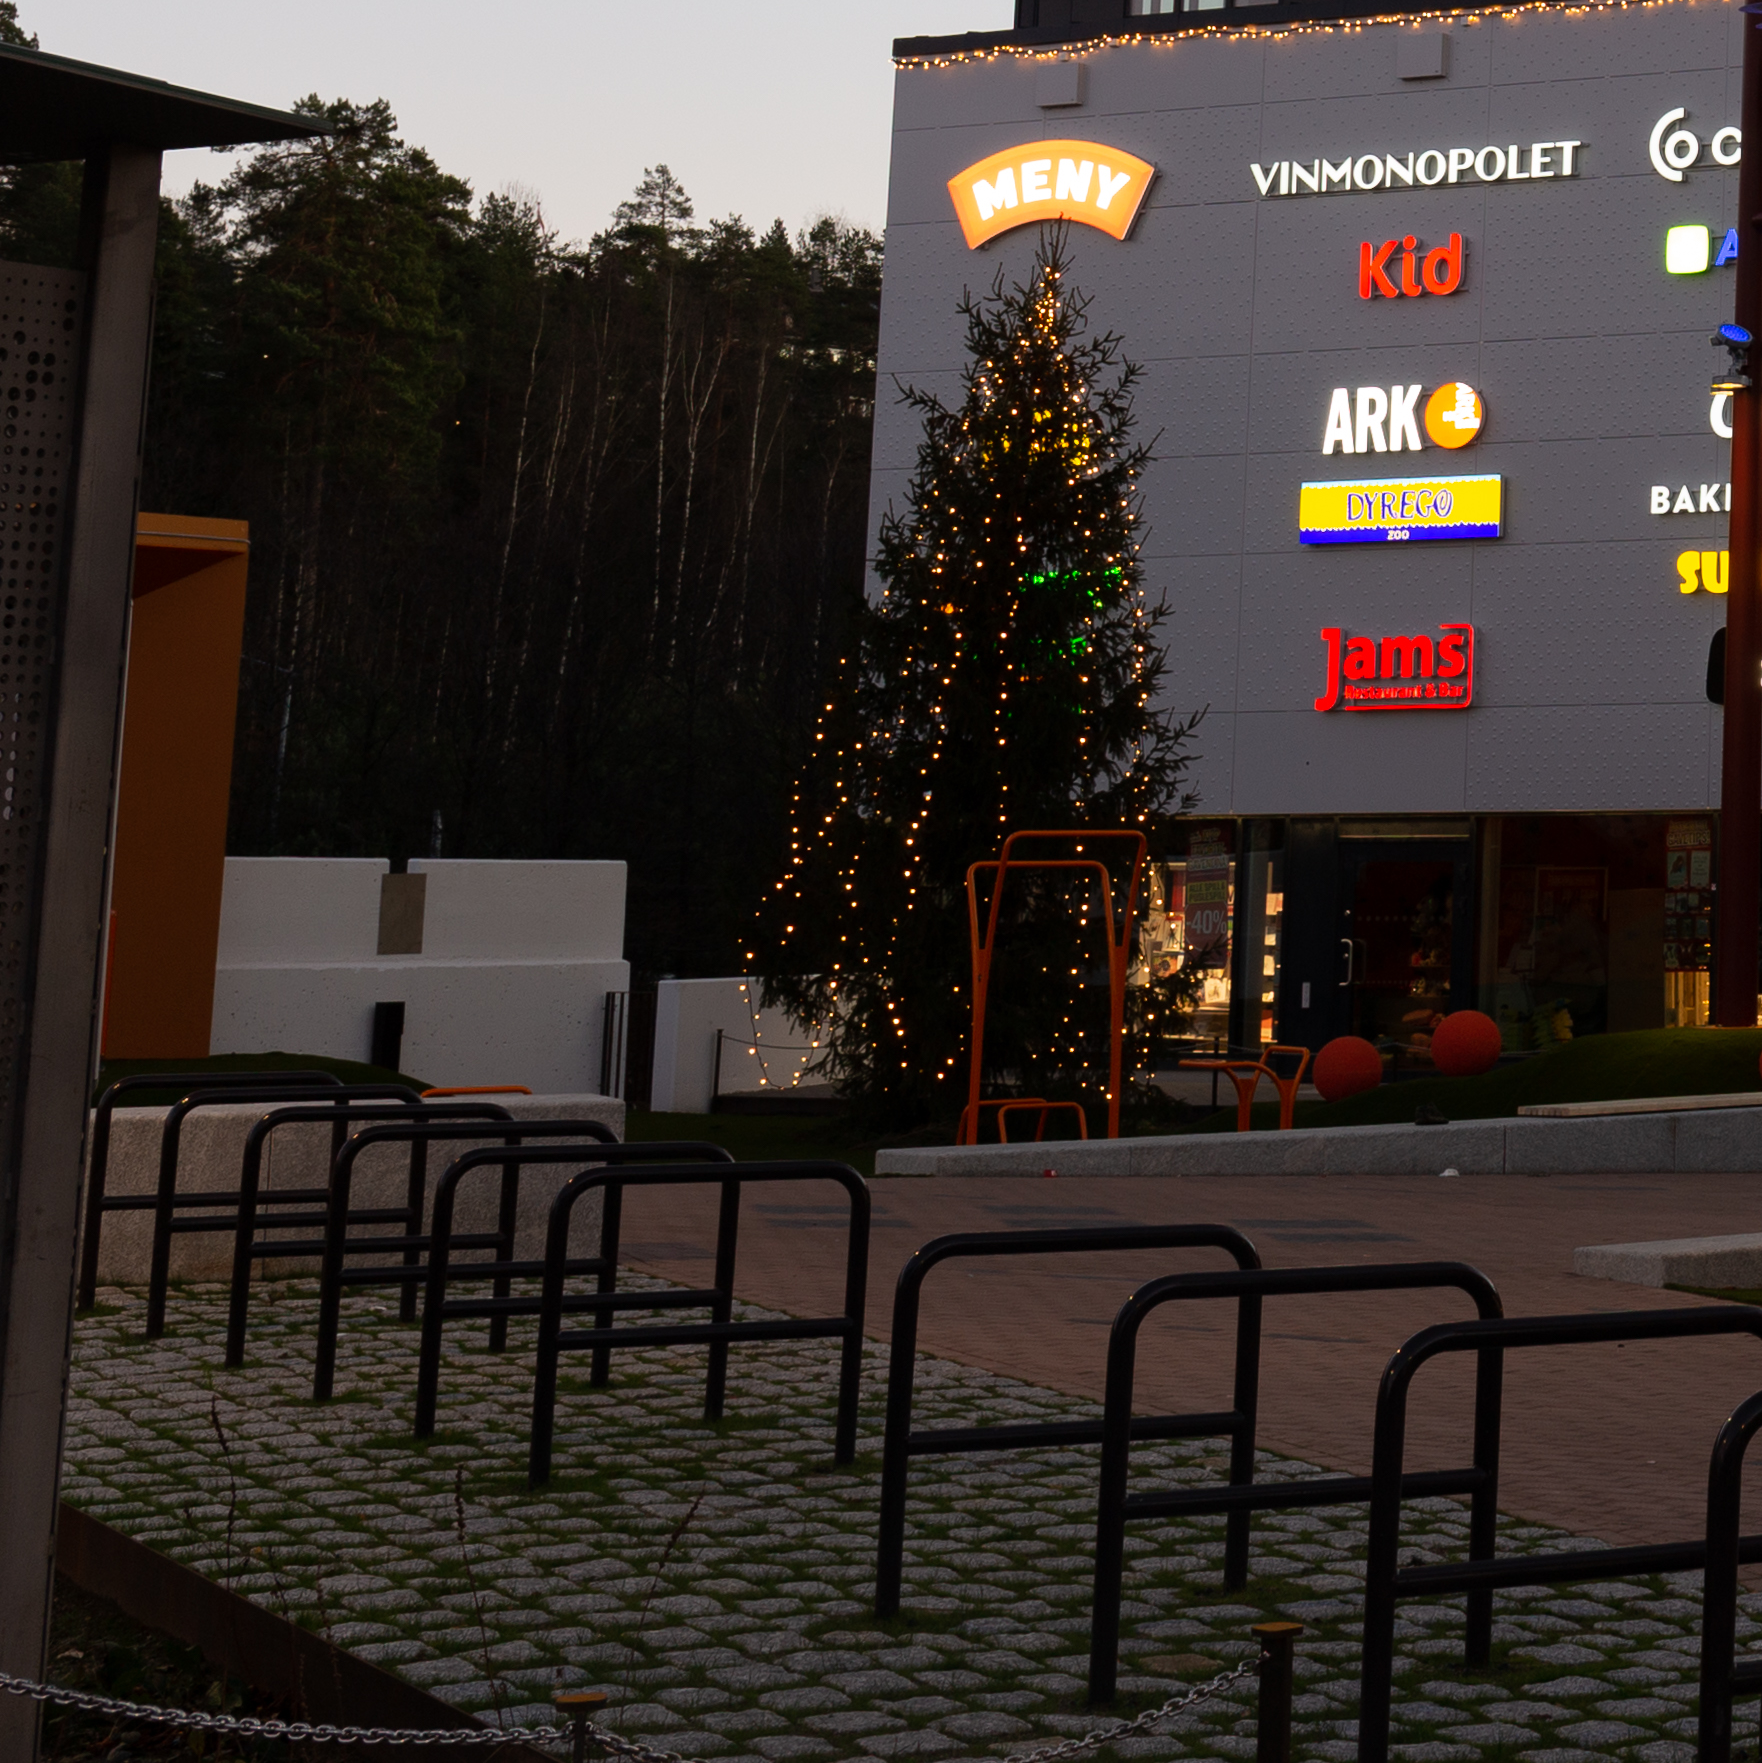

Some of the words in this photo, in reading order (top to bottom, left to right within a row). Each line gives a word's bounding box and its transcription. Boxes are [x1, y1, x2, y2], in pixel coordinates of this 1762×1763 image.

[971, 158, 1131, 220] MENY
[1251, 141, 1582, 195] VINMONOPOLET
[1359, 232, 1464, 299] Kid
[1322, 384, 1422, 455] ARK
[1347, 489, 1453, 521] DYREGO
[1314, 627, 1466, 712] Jams
[1344, 684, 1422, 700] Restaurant
[1425, 683, 1436, 698] &
[1438, 682, 1465, 697] Bar
[1186, 910, 1227, 935] -40%
